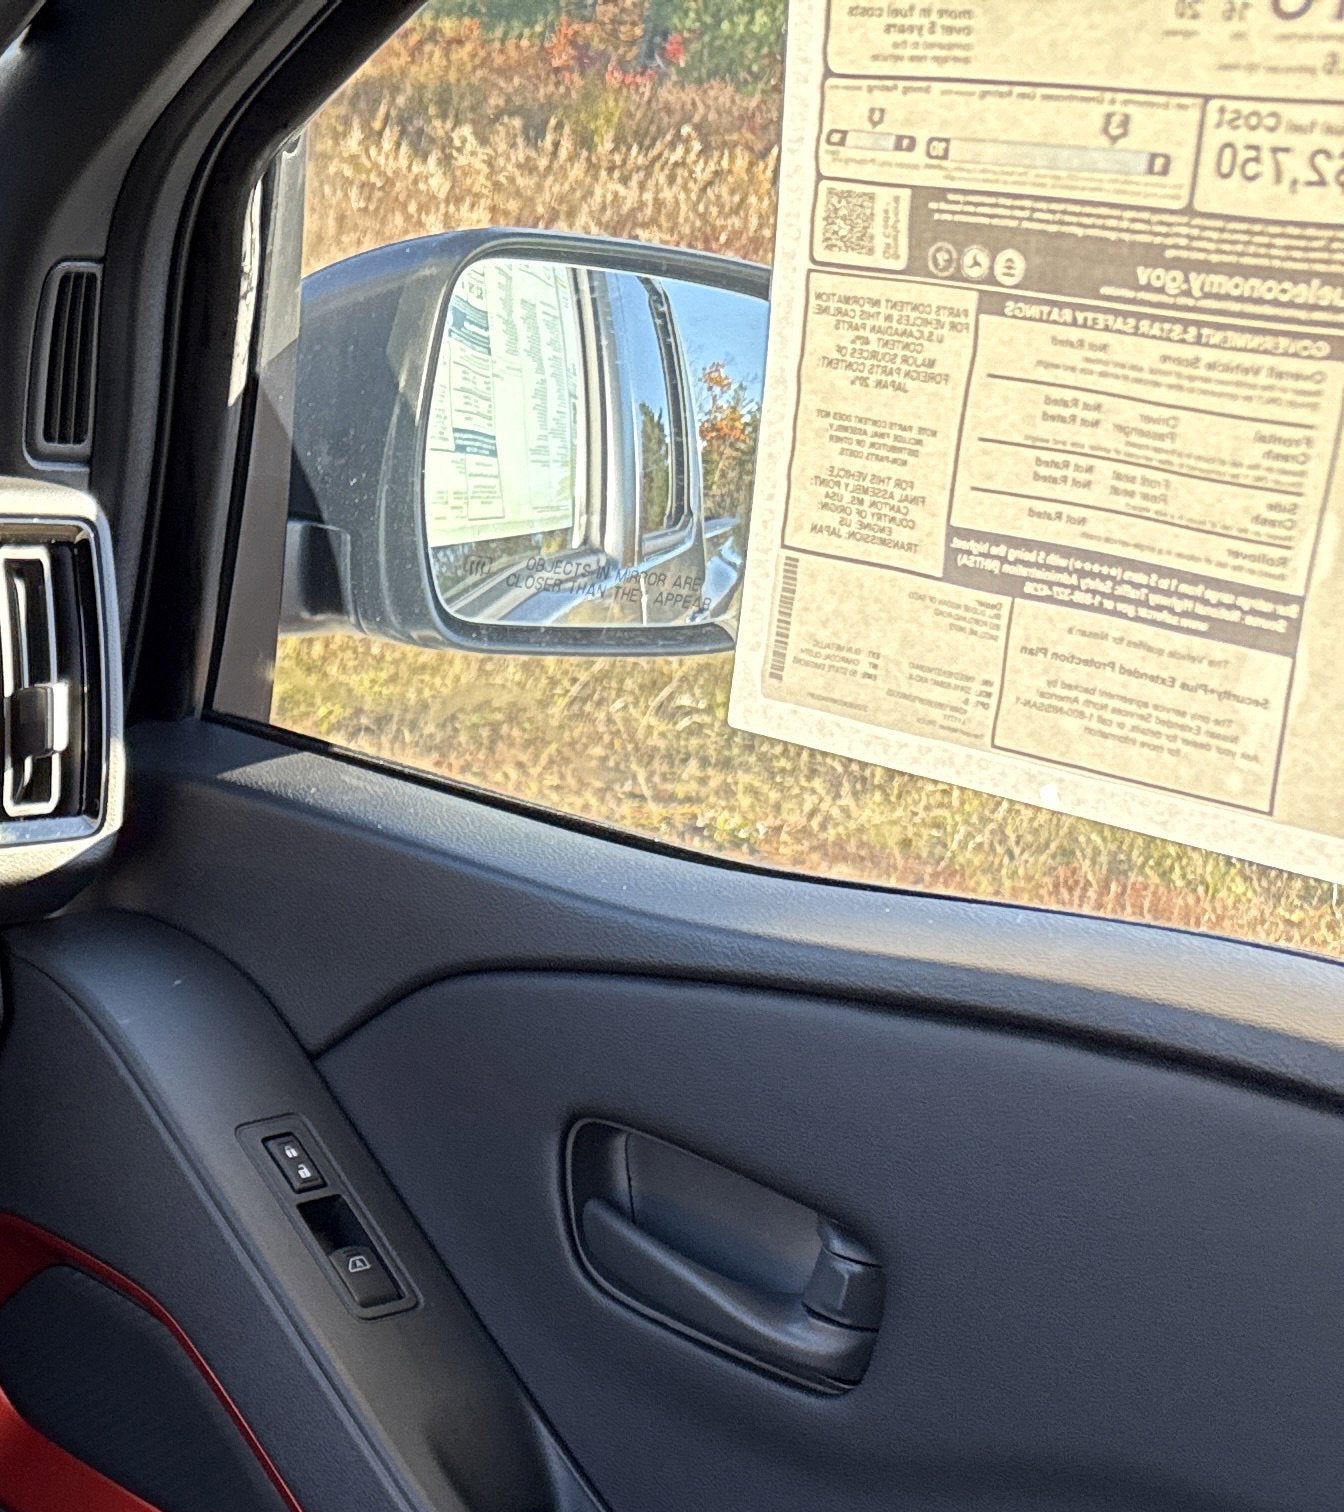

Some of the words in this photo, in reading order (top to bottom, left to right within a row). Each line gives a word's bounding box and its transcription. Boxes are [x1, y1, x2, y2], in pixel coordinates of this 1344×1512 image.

[505, 573, 561, 593] CLOSER
[569, 580, 606, 598] THAN
[655, 591, 712, 610] APPEAR
[525, 556, 592, 578] OBJECTS
[596, 565, 610, 581] IN
[614, 567, 667, 588] MIRROR
[672, 574, 702, 592] ARE
